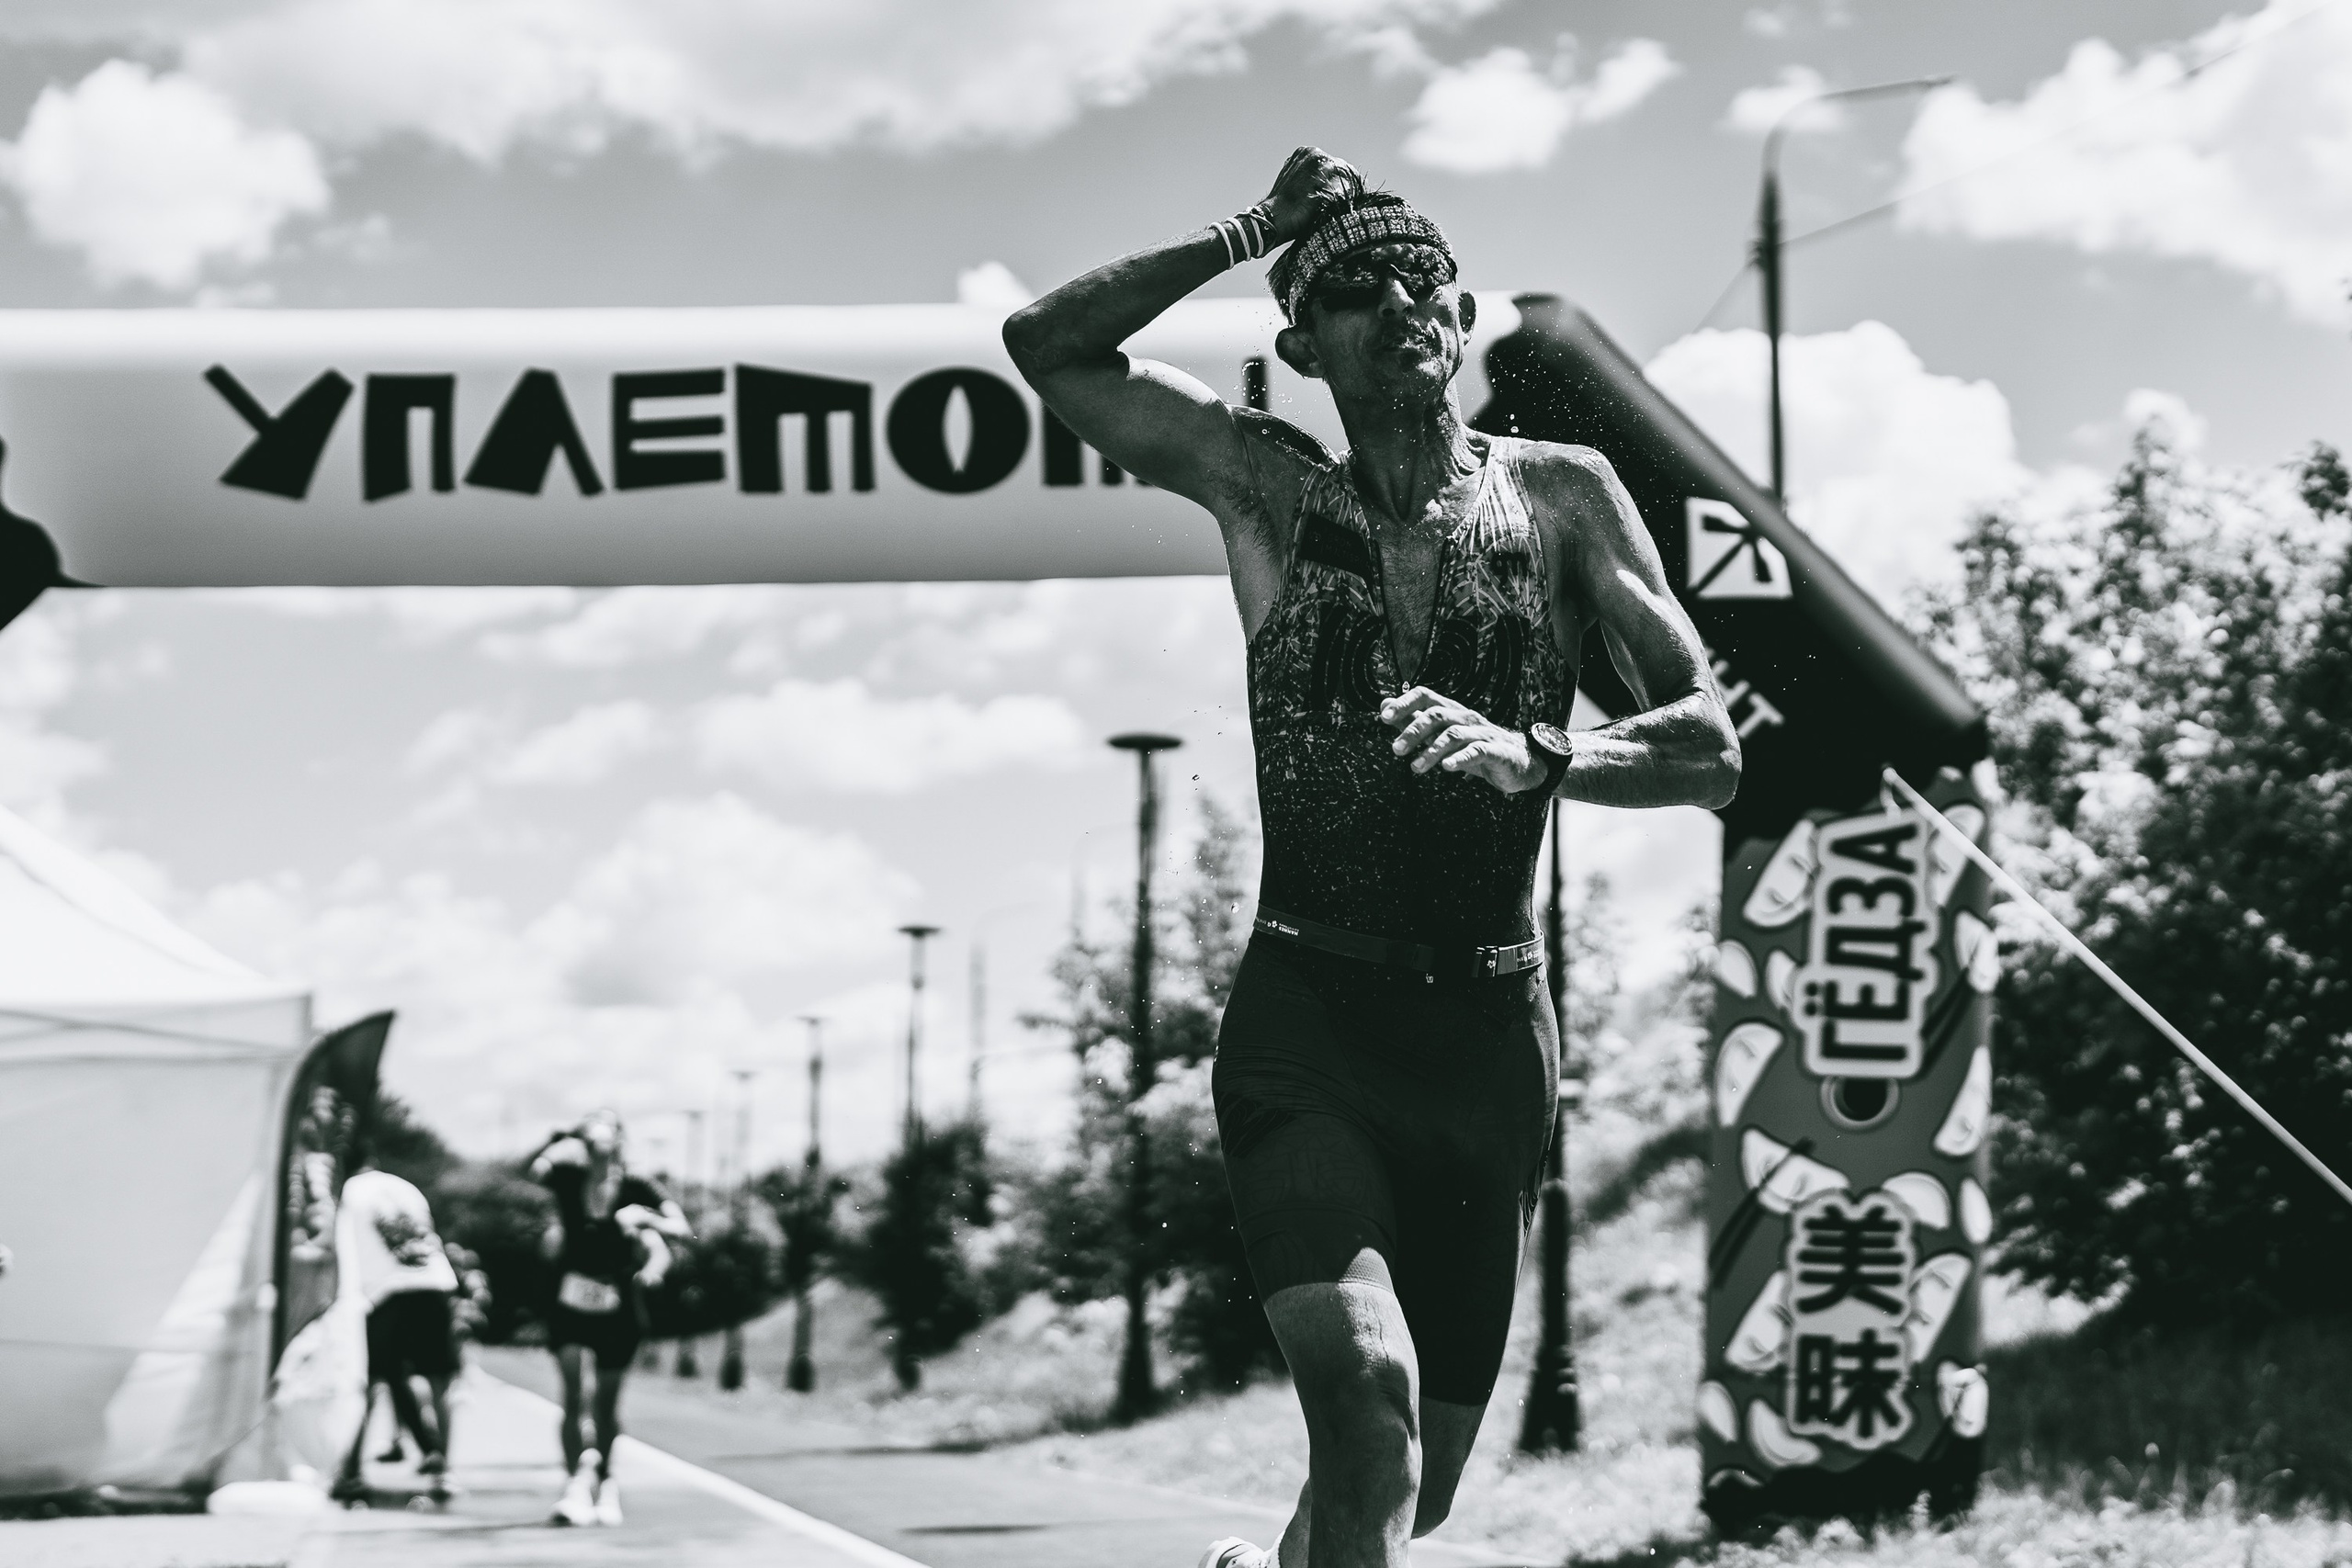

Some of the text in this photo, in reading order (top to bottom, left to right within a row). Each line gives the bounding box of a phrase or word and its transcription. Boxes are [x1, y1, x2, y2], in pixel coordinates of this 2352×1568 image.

[203, 361, 1269, 502] УПЛЕТО
[1804, 822, 1927, 1063] ГЁДЗА
[1793, 1202, 1905, 1439] 美味
